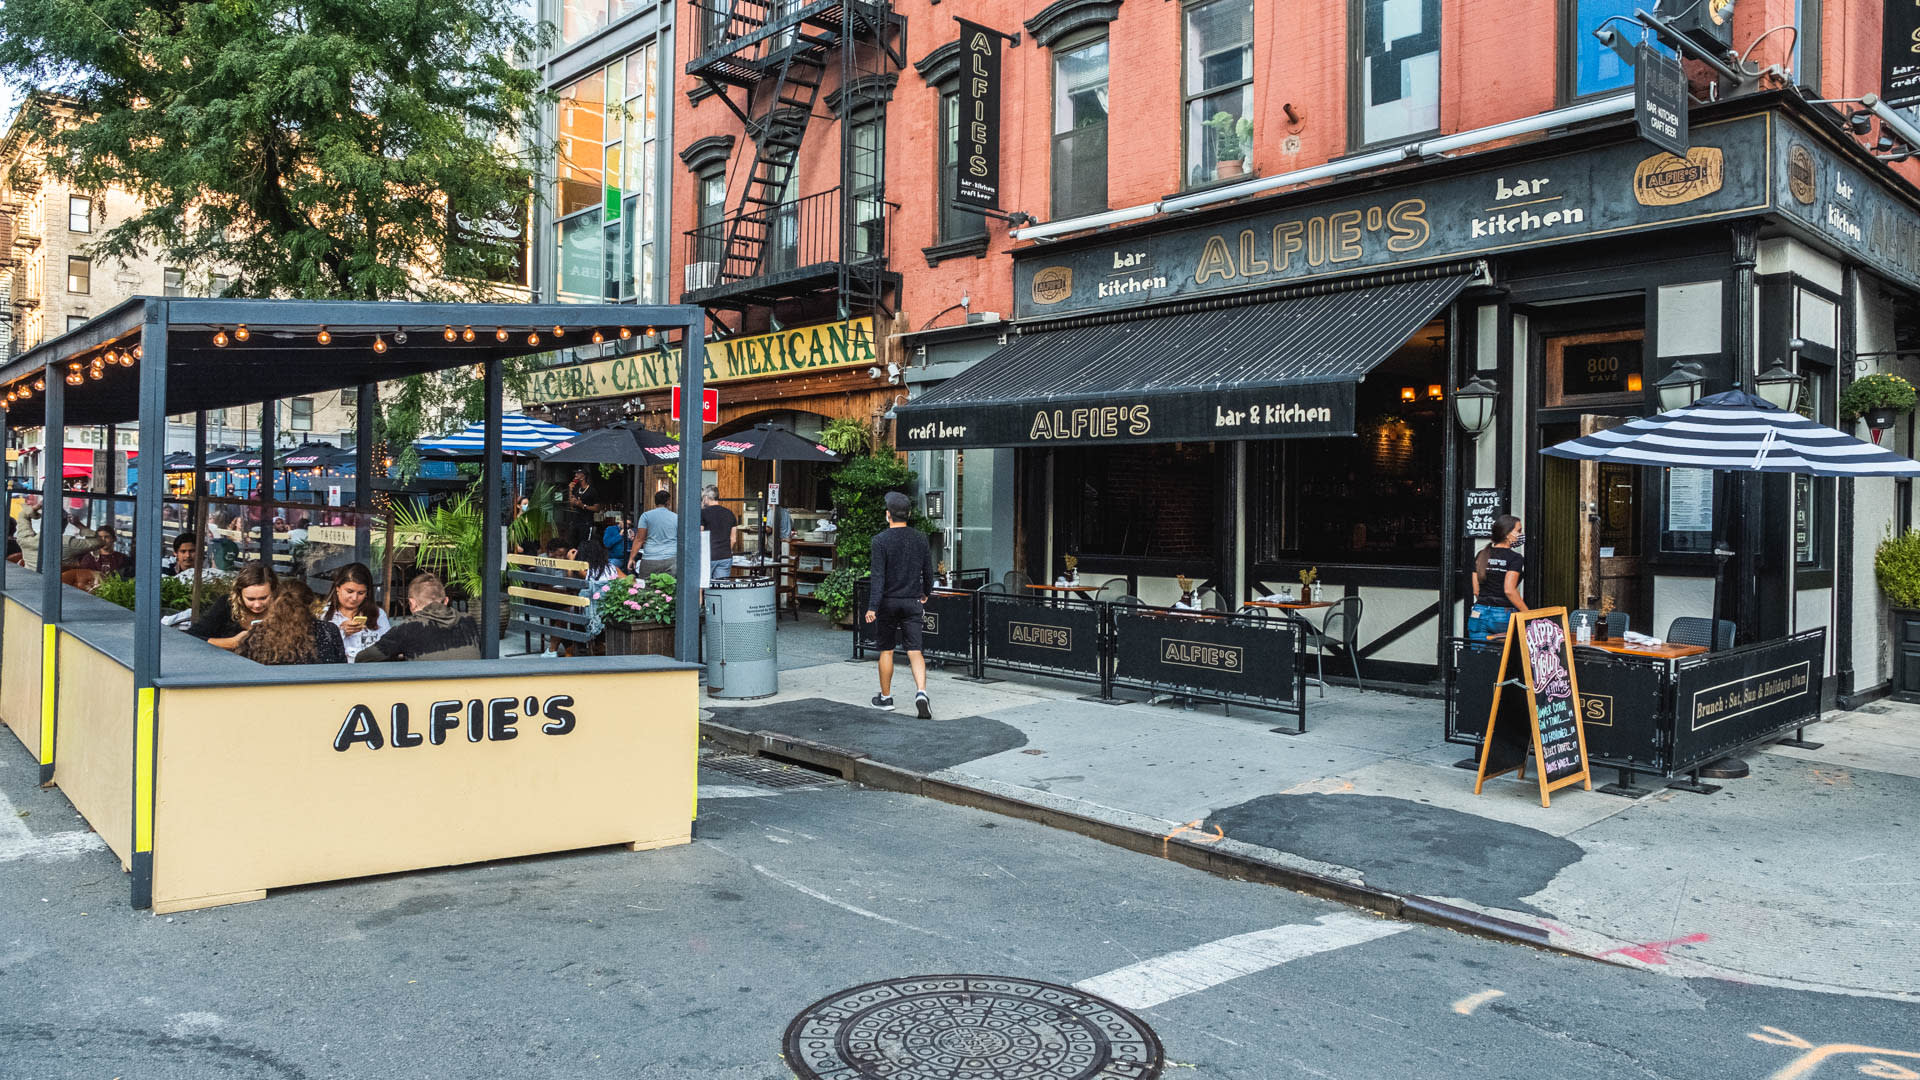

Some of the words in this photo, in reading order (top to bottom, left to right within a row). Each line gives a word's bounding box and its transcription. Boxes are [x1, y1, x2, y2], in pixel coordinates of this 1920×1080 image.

[1891, 65, 1915, 75] bar
[969, 32, 992, 177] ALFIE'S
[1646, 99, 1657, 115] BAR
[1657, 106, 1679, 127] KITCHEN
[1650, 116, 1665, 133] CRAFT
[1664, 123, 1677, 139] BEER
[1494, 177, 1550, 201] bar
[1648, 166, 1698, 189] ALFIE'S
[1835, 171, 1854, 200] bar
[1471, 207, 1584, 239] kitchen
[1828, 203, 1861, 242] kitchen
[1194, 198, 1431, 286] ALFIE'S
[1112, 251, 1146, 269] bar
[1098, 276, 1167, 299] kitchen
[611, 345, 719, 392] CANTIA
[727, 321, 876, 378] MEXICANA
[1587, 356, 1619, 374] 800
[1030, 404, 1151, 441] ALFIE'S
[1215, 405, 1247, 427] bar
[1249, 403, 1260, 424] &
[1264, 402, 1331, 424] kitchen
[907, 423, 937, 440] craft
[938, 422, 967, 440] beer
[1467, 496, 1501, 507] PLEASE
[1472, 504, 1494, 515] wait
[1466, 519, 1493, 530] SEATE
[1472, 515, 1482, 523] to
[1483, 515, 1495, 525] be
[534, 557, 556, 567] TACUBA
[1012, 624, 1068, 647] ALFIE'S
[1526, 622, 1564, 655] HAPPY
[1165, 643, 1239, 668] ALFIE'S
[1696, 696, 1723, 719] Brunch
[1728, 692, 1743, 708] Sat,
[1743, 687, 1757, 704] Sun
[1757, 683, 1763, 699] &
[1764, 678, 1791, 697] Holidays
[333, 694, 576, 753] ALFIE'S
